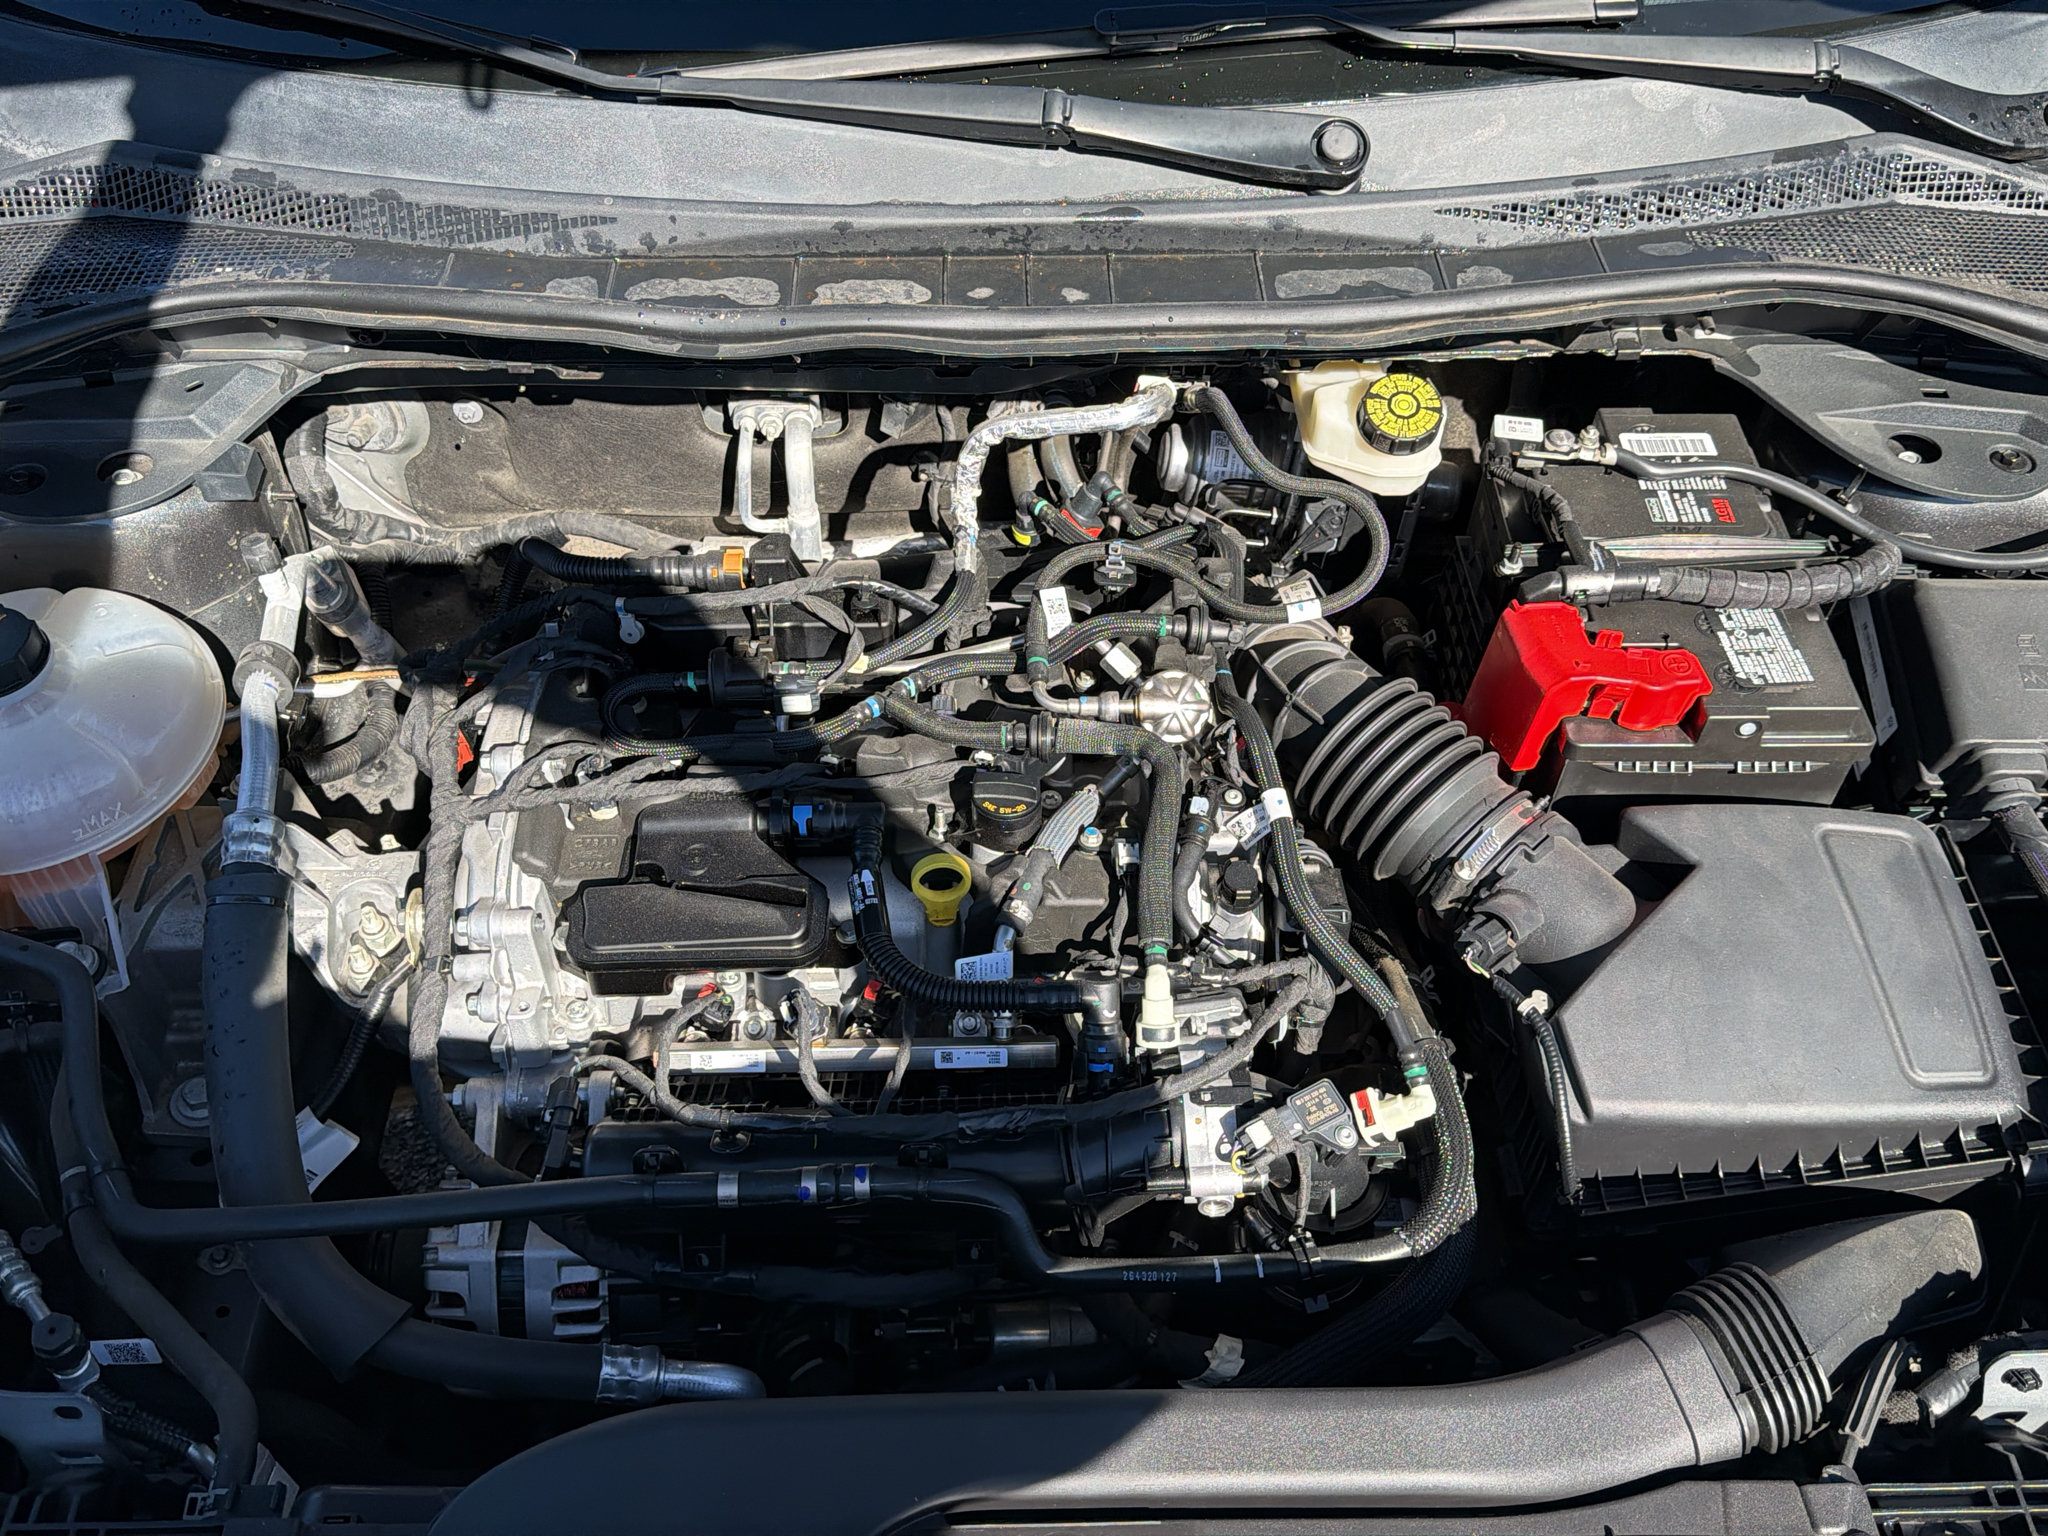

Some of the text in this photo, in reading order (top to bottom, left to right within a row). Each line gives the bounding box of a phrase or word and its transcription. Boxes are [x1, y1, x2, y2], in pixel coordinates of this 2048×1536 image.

[1711, 498, 1731, 522] AGM
[982, 801, 1027, 814] SAE 5W-20
[81, 801, 129, 834] MAX
[1160, 1271, 1177, 1282] 127
